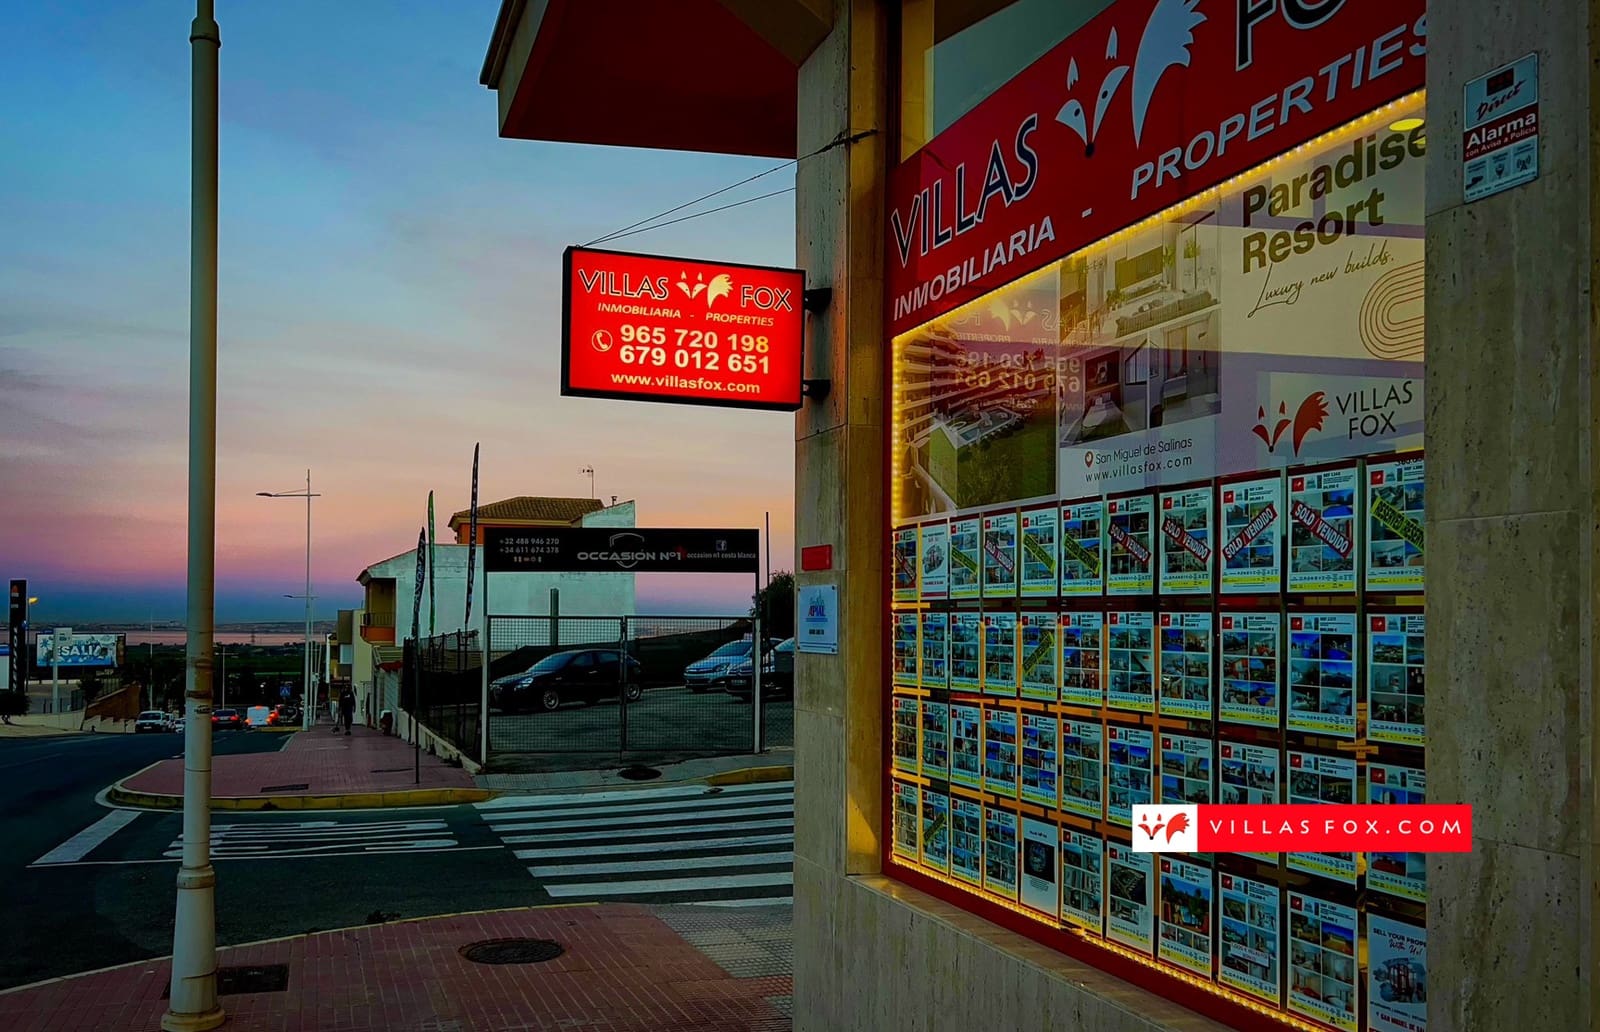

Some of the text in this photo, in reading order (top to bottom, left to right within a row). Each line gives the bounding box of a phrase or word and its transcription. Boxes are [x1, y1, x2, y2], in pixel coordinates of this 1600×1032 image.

[1466, 112, 1537, 150] Alarma
[894, 215, 1056, 321] INMOBILIARIA
[1130, 13, 1426, 201] PROPERTIES
[1242, 122, 1425, 228] Paradise
[891, 113, 1038, 269] VILLAS
[1242, 187, 1385, 274] Resort
[578, 268, 793, 313] VILLAS FOX
[1247, 238, 1395, 319] Luxury new builds.
[597, 302, 682, 319] INMOBILIARIA
[705, 312, 775, 327] PROPERTIES
[619, 324, 769, 353] 965 720 198
[619, 345, 769, 374] 679 012 651
[610, 372, 761, 394] www.villasfox.com
[1336, 380, 1413, 415] VILLAS
[1349, 411, 1396, 440] FOX
[1095, 438, 1193, 465] San Miguel de Salinas
[1085, 456, 1193, 482] www.villasfox.com
[1164, 519, 1181, 538] SOLD
[1224, 536, 1244, 559] SOLD
[1243, 506, 1274, 539] VENDIDO
[1294, 503, 1316, 526] SOLD
[1316, 520, 1350, 554] VENDIDO
[515, 546, 529, 554] 611
[577, 549, 656, 561] OCCASIÓN
[721, 551, 737, 559] costa
[737, 551, 757, 559] blanca
